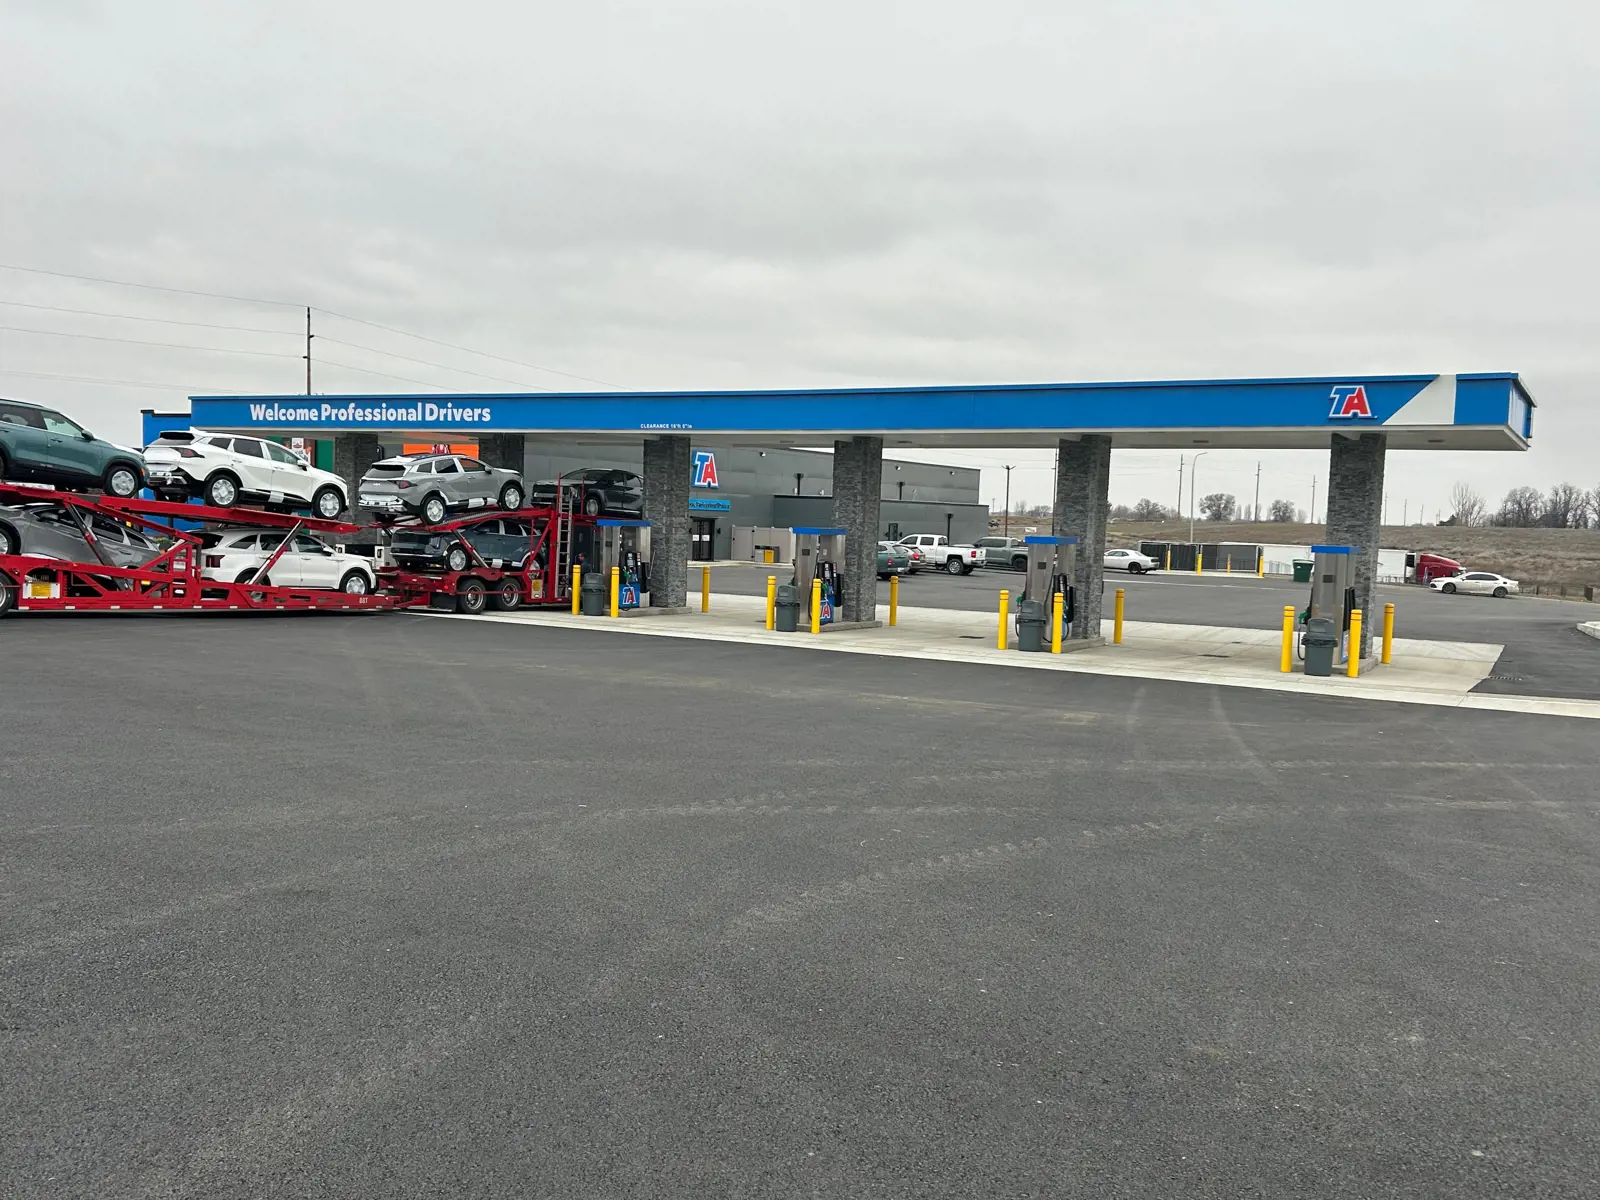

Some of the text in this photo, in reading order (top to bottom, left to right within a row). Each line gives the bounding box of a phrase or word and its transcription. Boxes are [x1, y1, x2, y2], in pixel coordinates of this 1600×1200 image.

[250, 402, 491, 422] Welcome Professional Drivers
[1328, 385, 1373, 418] TA
[694, 451, 719, 487] TA
